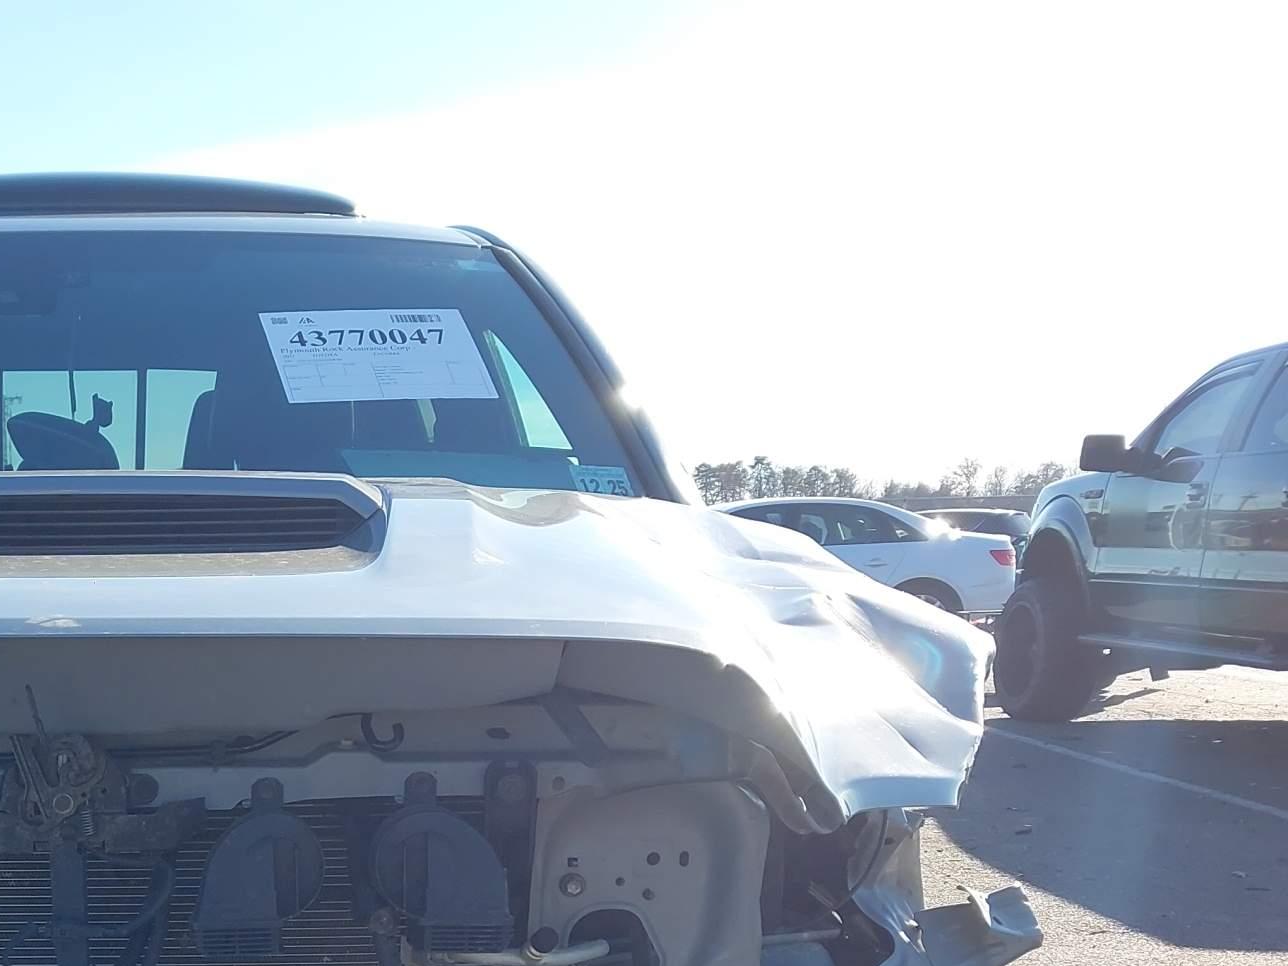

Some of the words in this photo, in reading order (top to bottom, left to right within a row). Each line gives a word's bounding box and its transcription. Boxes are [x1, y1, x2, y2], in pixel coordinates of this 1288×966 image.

[289, 328, 445, 347] 43770047
[580, 478, 601, 493] 12
[607, 479, 629, 497] 25
